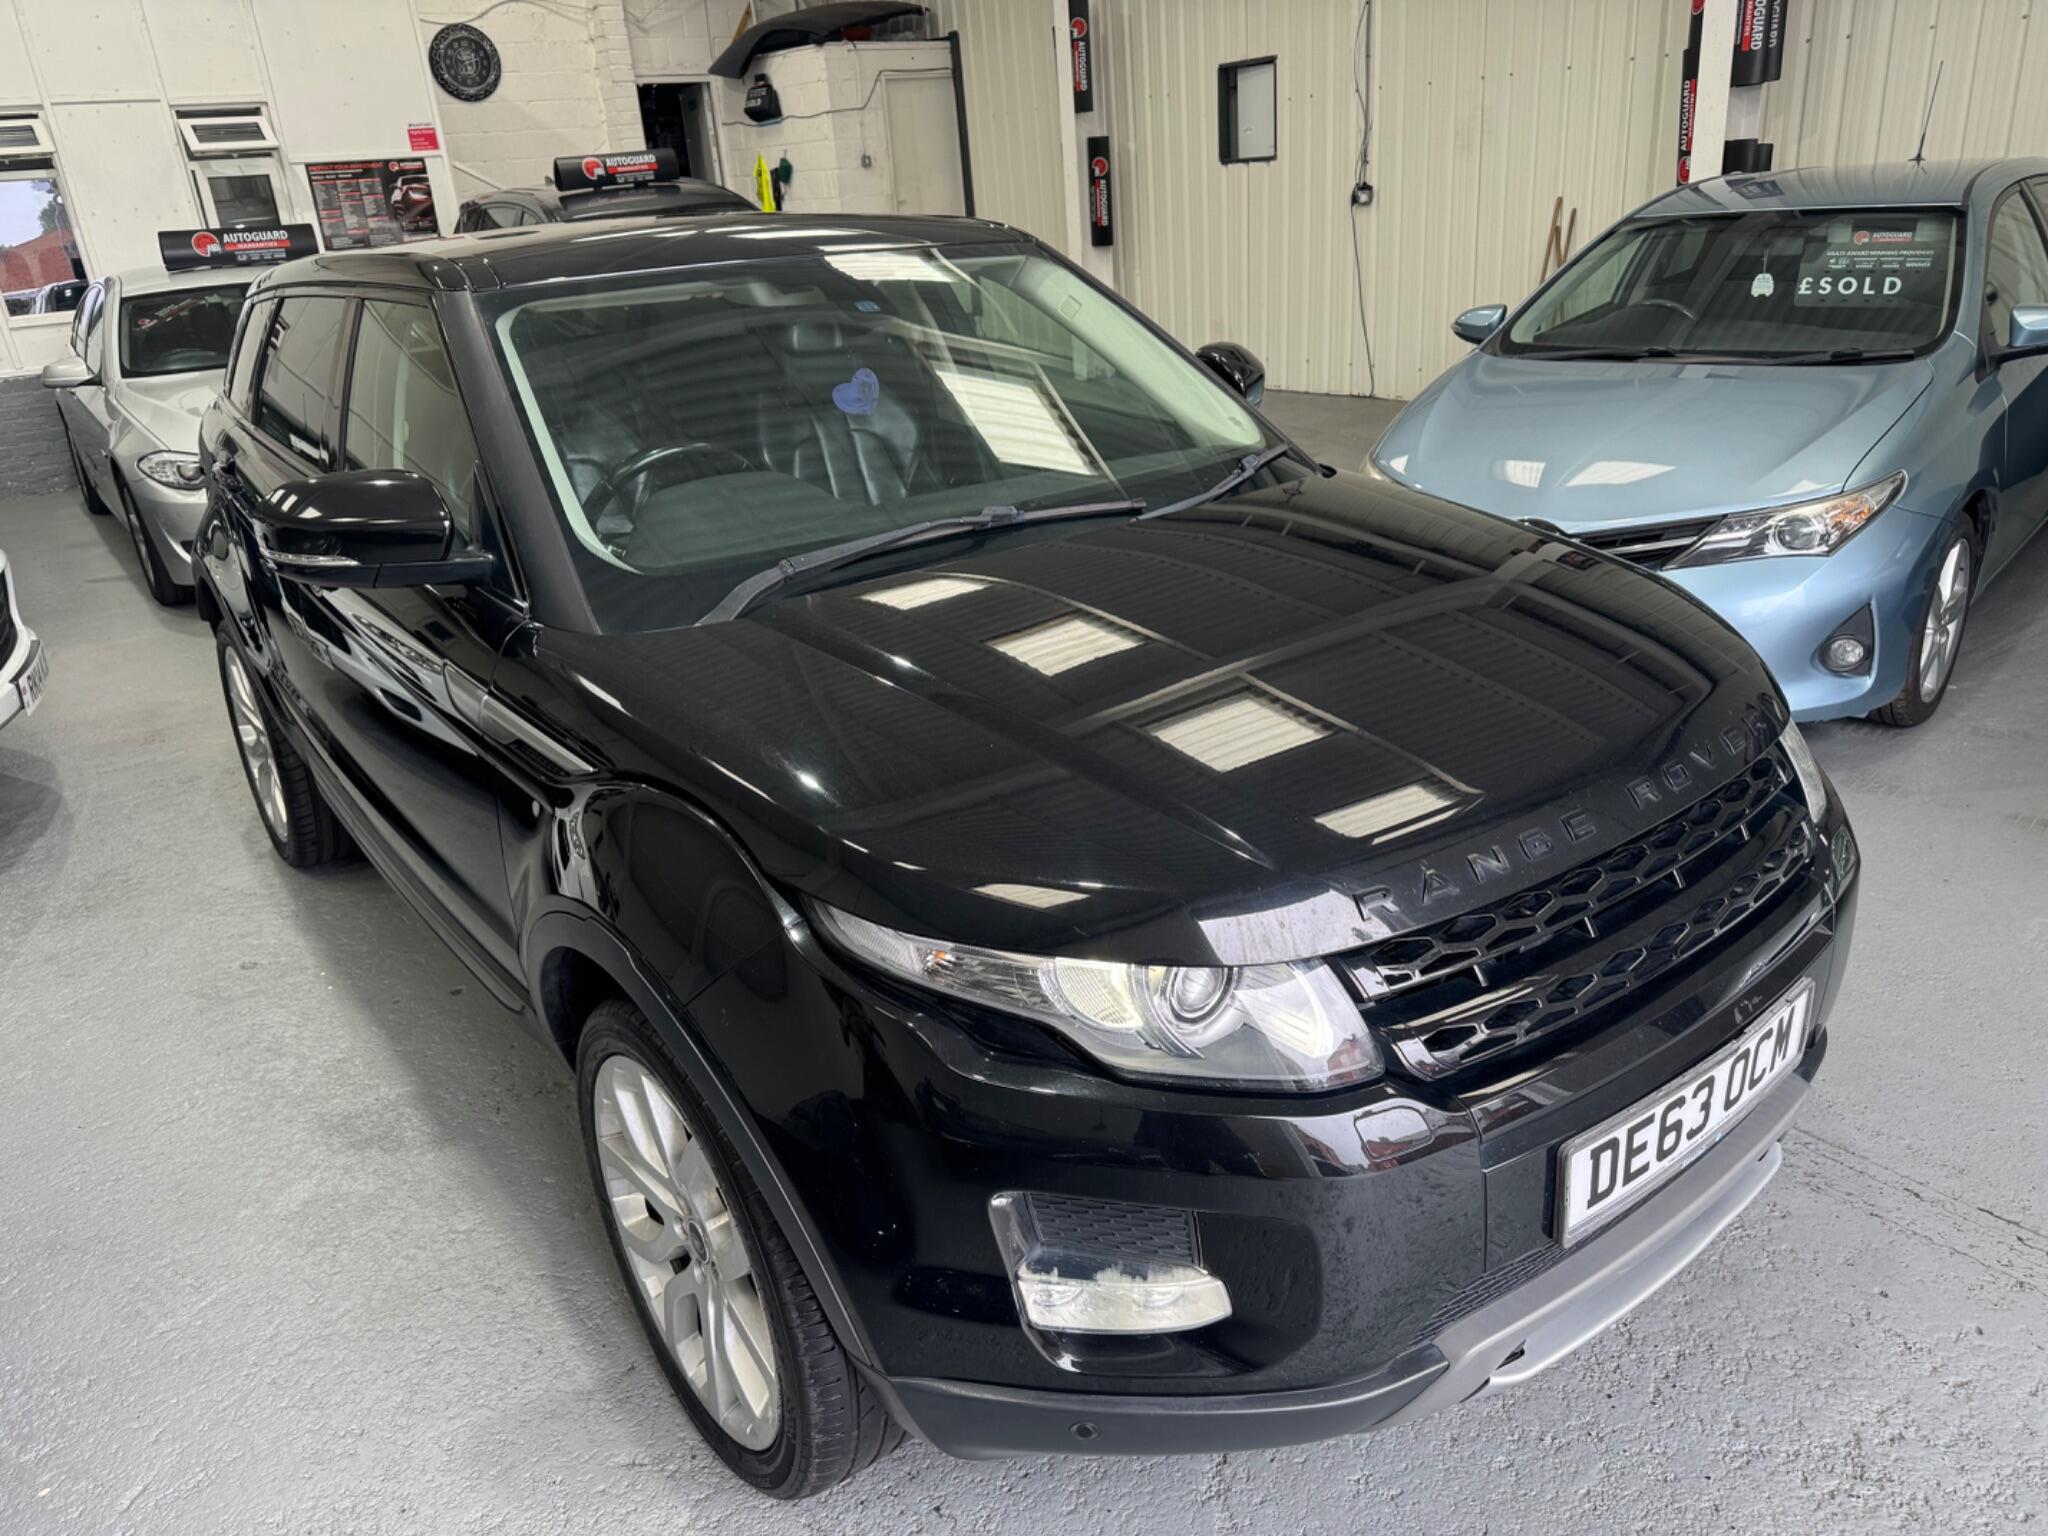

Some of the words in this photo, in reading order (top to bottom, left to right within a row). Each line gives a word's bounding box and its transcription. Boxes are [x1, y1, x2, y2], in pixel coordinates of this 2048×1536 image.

[1679, 80, 1690, 151] AUTOGUARD
[606, 154, 656, 167] AUTOGUARD
[1100, 179, 1109, 227] AUTOGUARD
[223, 230, 288, 244] AUTOGUARD
[1872, 231, 1912, 239] AUTOGUARD
[1353, 805, 1597, 922] RANGE
[1624, 710, 1769, 810] ROVER
[1586, 1074, 1716, 1211] DE63
[1723, 1004, 1796, 1113] OCM
